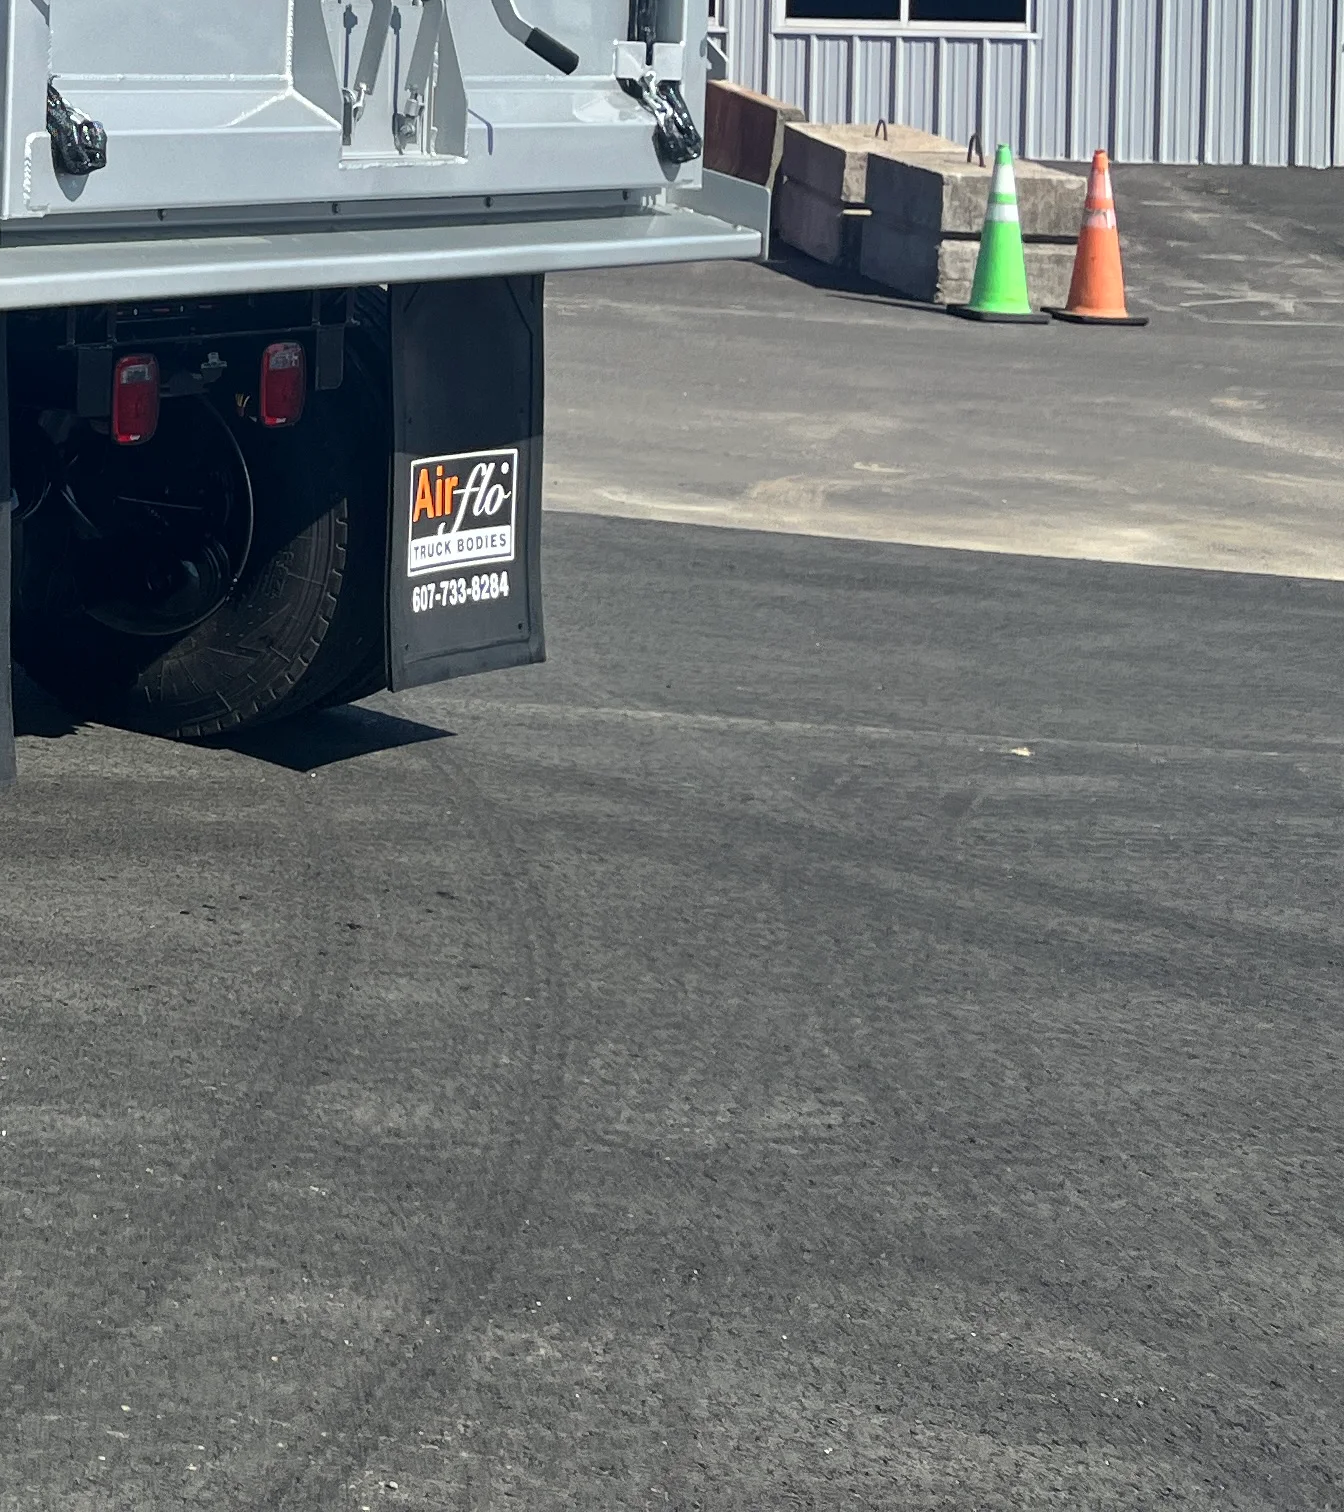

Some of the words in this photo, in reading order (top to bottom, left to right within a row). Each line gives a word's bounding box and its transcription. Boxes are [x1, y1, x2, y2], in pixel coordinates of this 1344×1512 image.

[413, 540, 452, 561] TRUCK
[456, 533, 508, 553] BODIES
[412, 570, 511, 614] 607-733-8284
